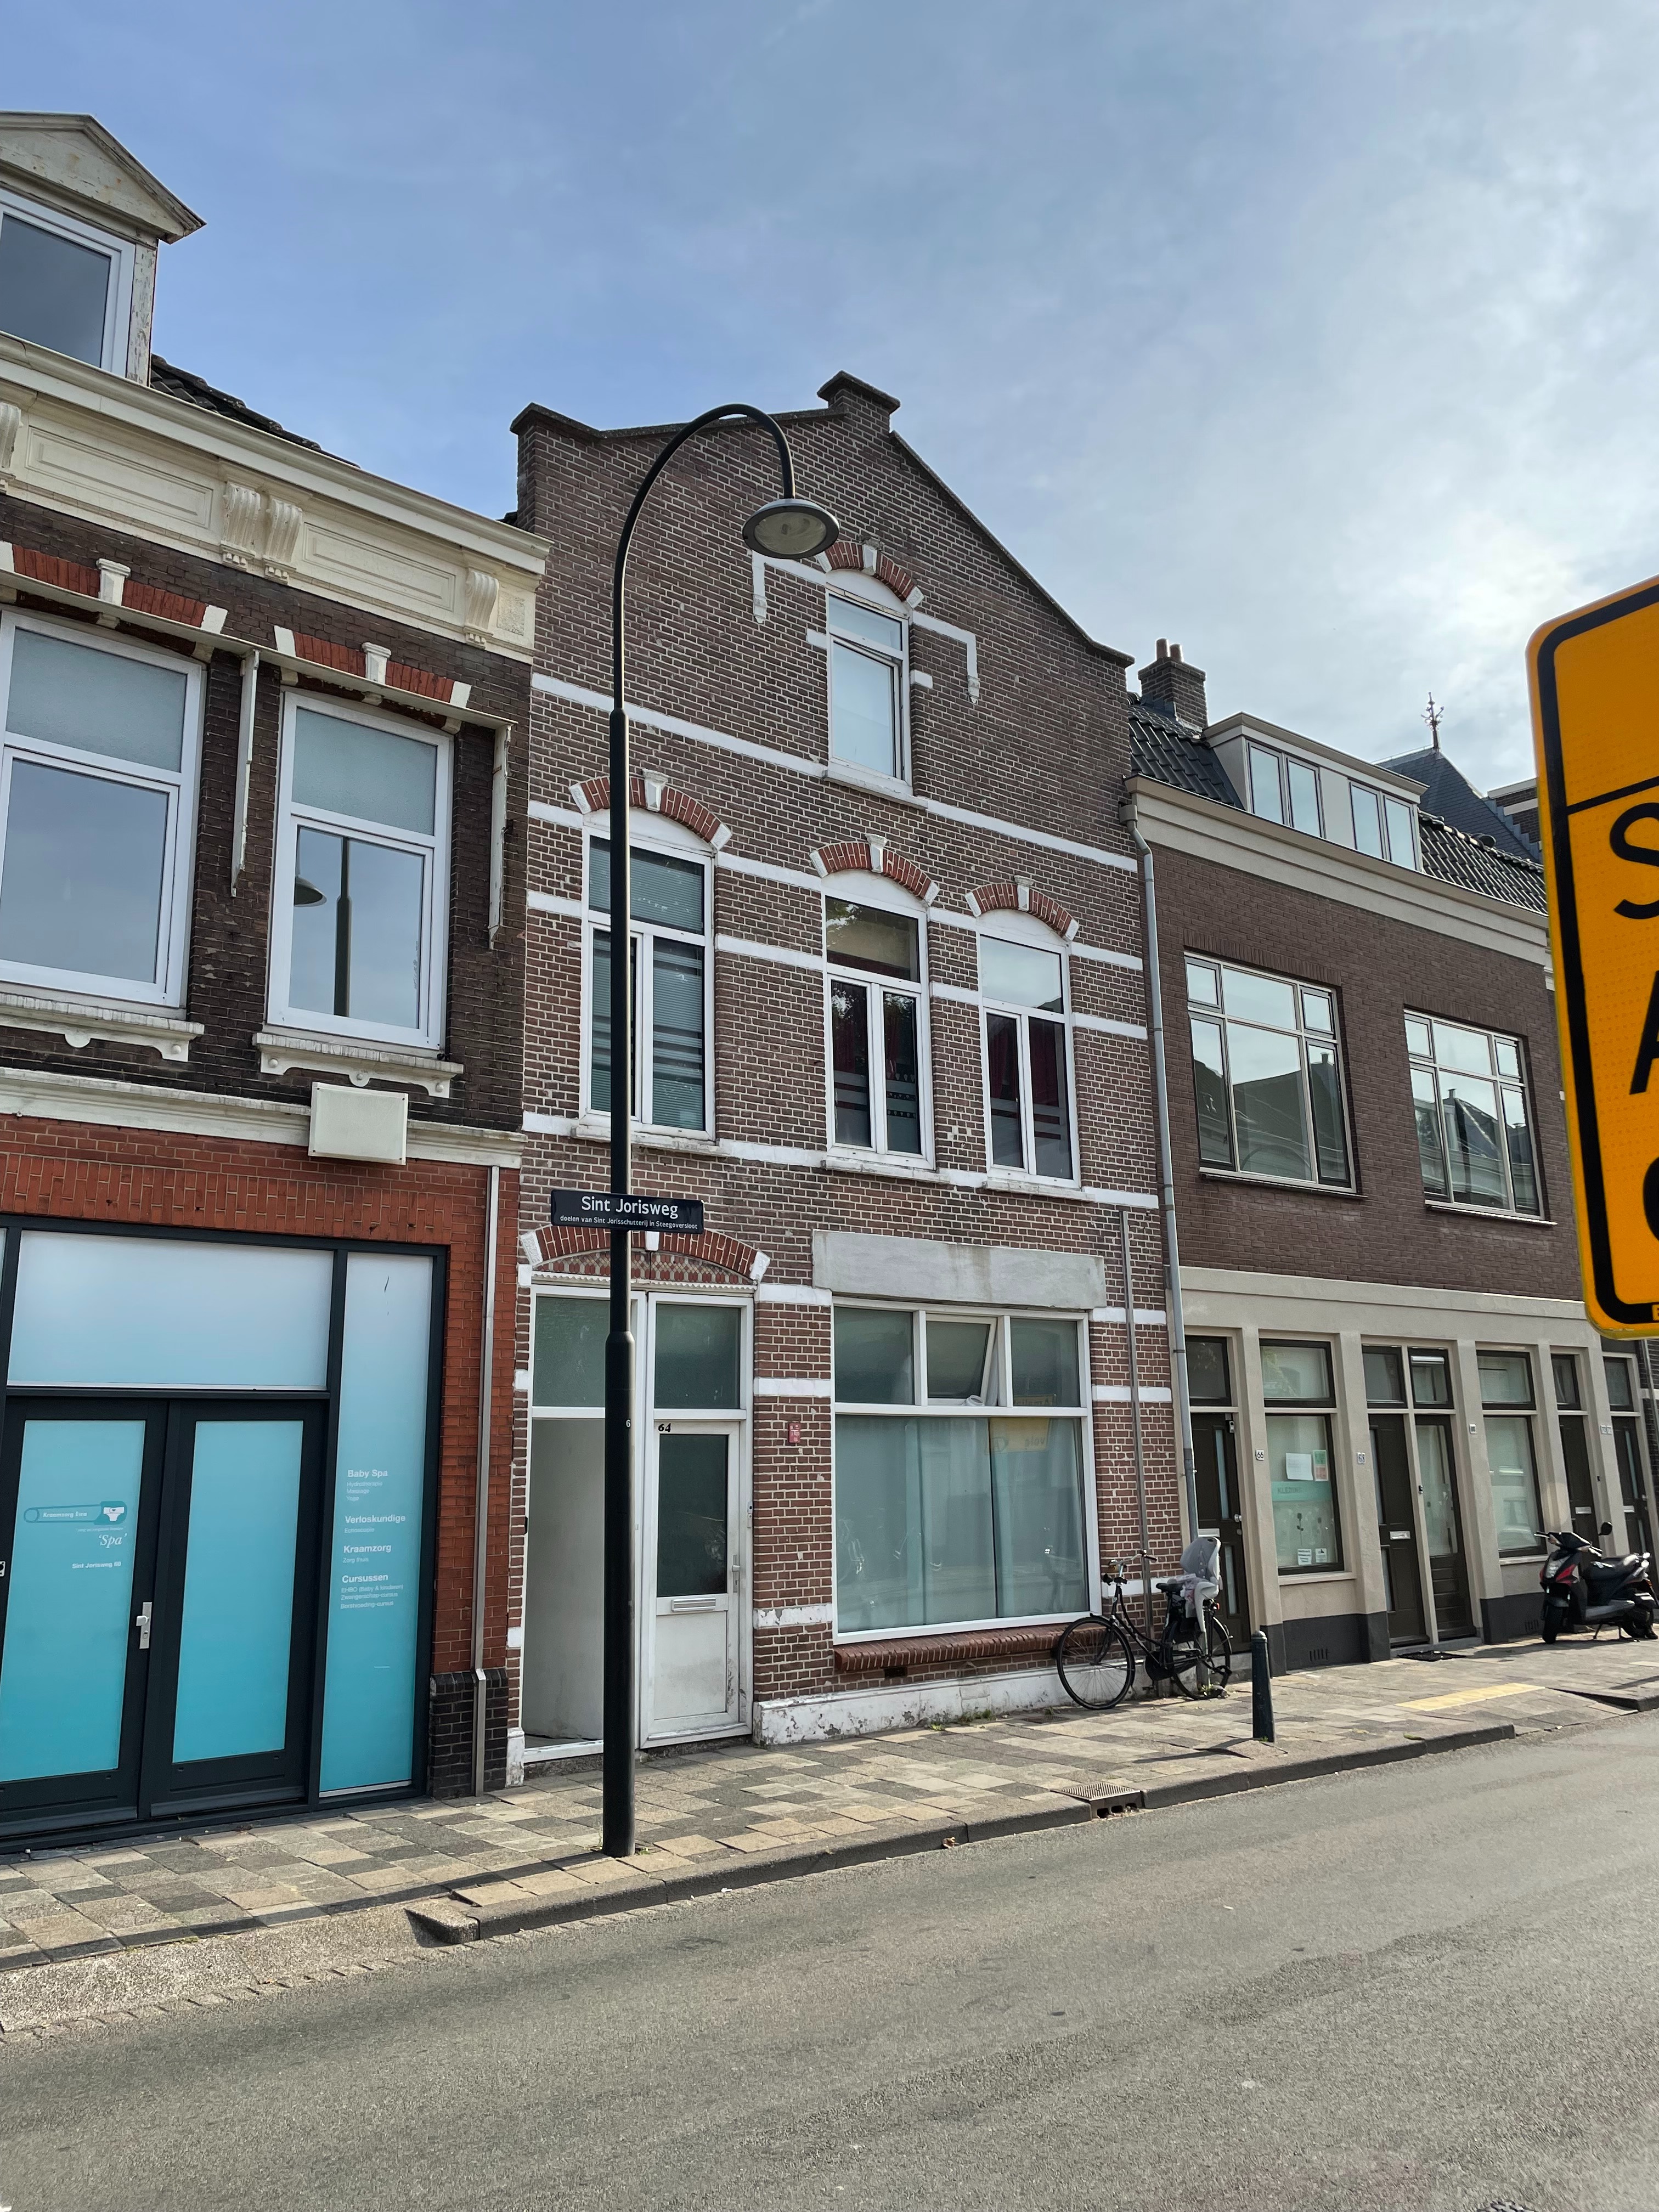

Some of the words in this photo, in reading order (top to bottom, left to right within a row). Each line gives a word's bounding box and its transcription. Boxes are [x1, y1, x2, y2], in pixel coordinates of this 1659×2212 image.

[582, 1196, 611, 1212] Sint
[616, 1198, 678, 1220] Jorisweg
[607, 1218, 648, 1227] Jorisschutterij
[656, 1221, 698, 1229] Steegoversloot
[626, 1419, 631, 1427] 6
[658, 1423, 671, 1432] 64
[347, 1470, 370, 1479] Baby
[371, 1469, 388, 1479] Spa
[345, 1514, 406, 1523] Verloskundige
[343, 1544, 392, 1553] Kraamzorg
[342, 1575, 388, 1583] Cursussen
